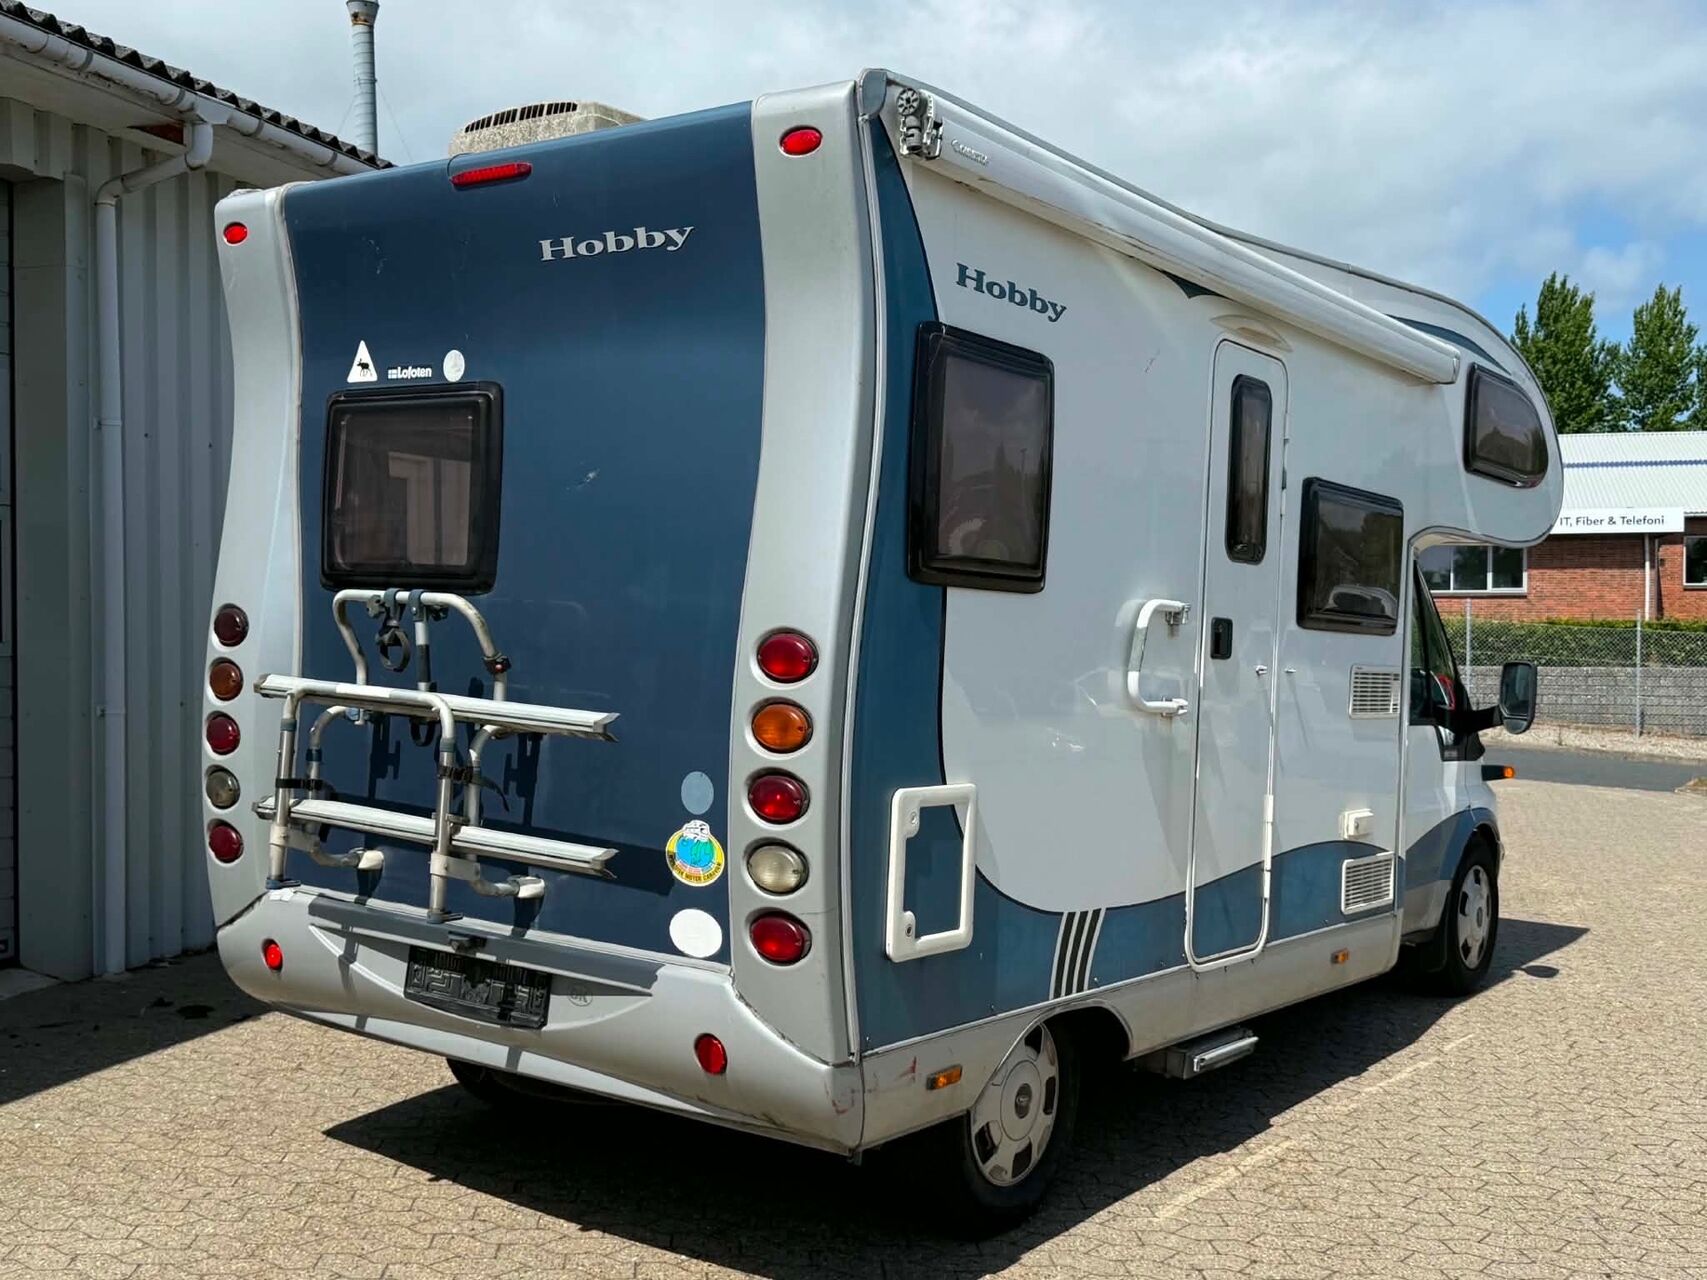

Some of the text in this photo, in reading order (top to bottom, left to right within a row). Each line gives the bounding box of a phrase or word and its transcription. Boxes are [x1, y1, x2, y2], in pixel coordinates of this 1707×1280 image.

[539, 226, 695, 261] Hobby
[956, 262, 1067, 322] Hobby
[397, 366, 432, 379] Lofoten
[1559, 515, 1665, 527] IT, Fiber & Telefoni
